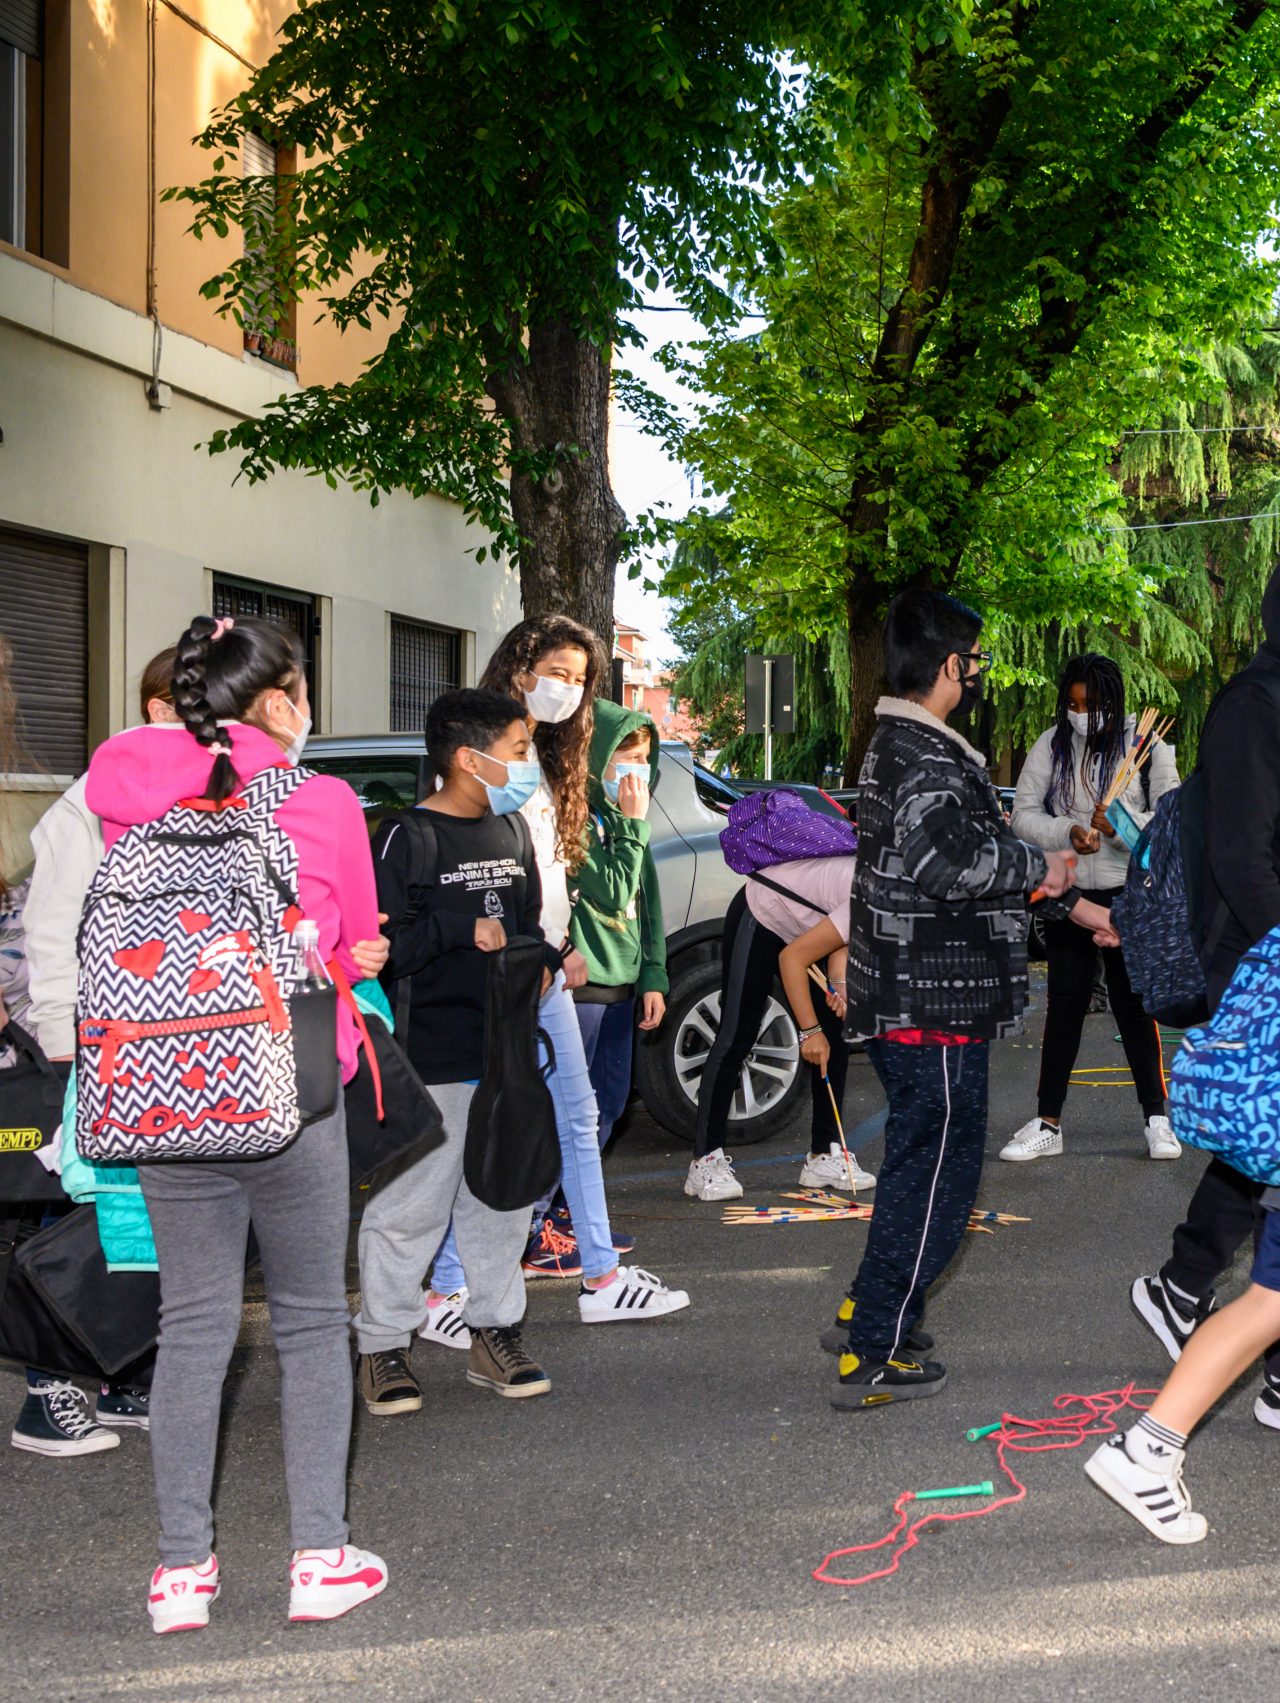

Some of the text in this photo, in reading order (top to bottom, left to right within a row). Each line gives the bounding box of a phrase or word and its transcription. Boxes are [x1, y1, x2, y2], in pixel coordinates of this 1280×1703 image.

[458, 862, 479, 871] NEW
[440, 869, 483, 885] DENIM
[483, 868, 491, 878] &
[91, 1083, 271, 1137] Love
